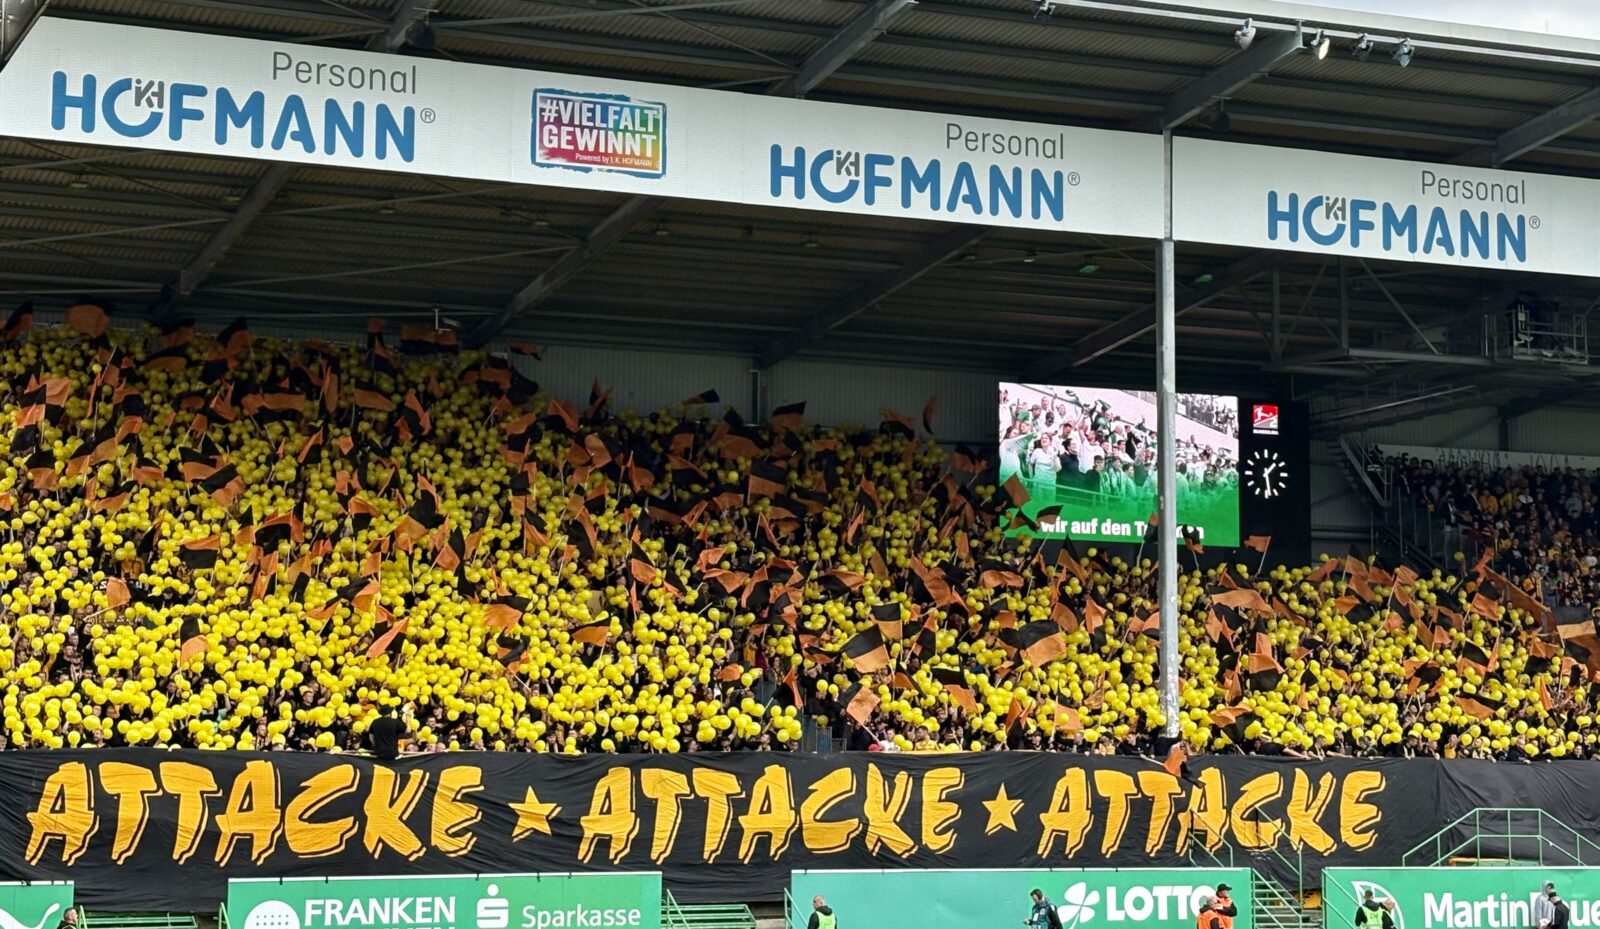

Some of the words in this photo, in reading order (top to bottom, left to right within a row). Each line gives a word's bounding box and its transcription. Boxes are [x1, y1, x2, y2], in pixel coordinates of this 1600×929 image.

[272, 51, 416, 95] Personal
[541, 99, 657, 133] #VIELFALT
[542, 124, 657, 158] GEWINNT
[575, 152, 601, 162] Powered
[602, 155, 610, 164] by
[946, 122, 1064, 160] Personal
[1421, 170, 1526, 205] Personal
[1070, 518, 1099, 535] auf
[1101, 519, 1131, 536] den
[25, 759, 486, 867] ATTACKE
[577, 762, 965, 865] ATTACKE
[1036, 765, 1387, 860] ATTACKE
[304, 896, 456, 926] FRANKEN
[522, 903, 641, 929] Sparkasse
